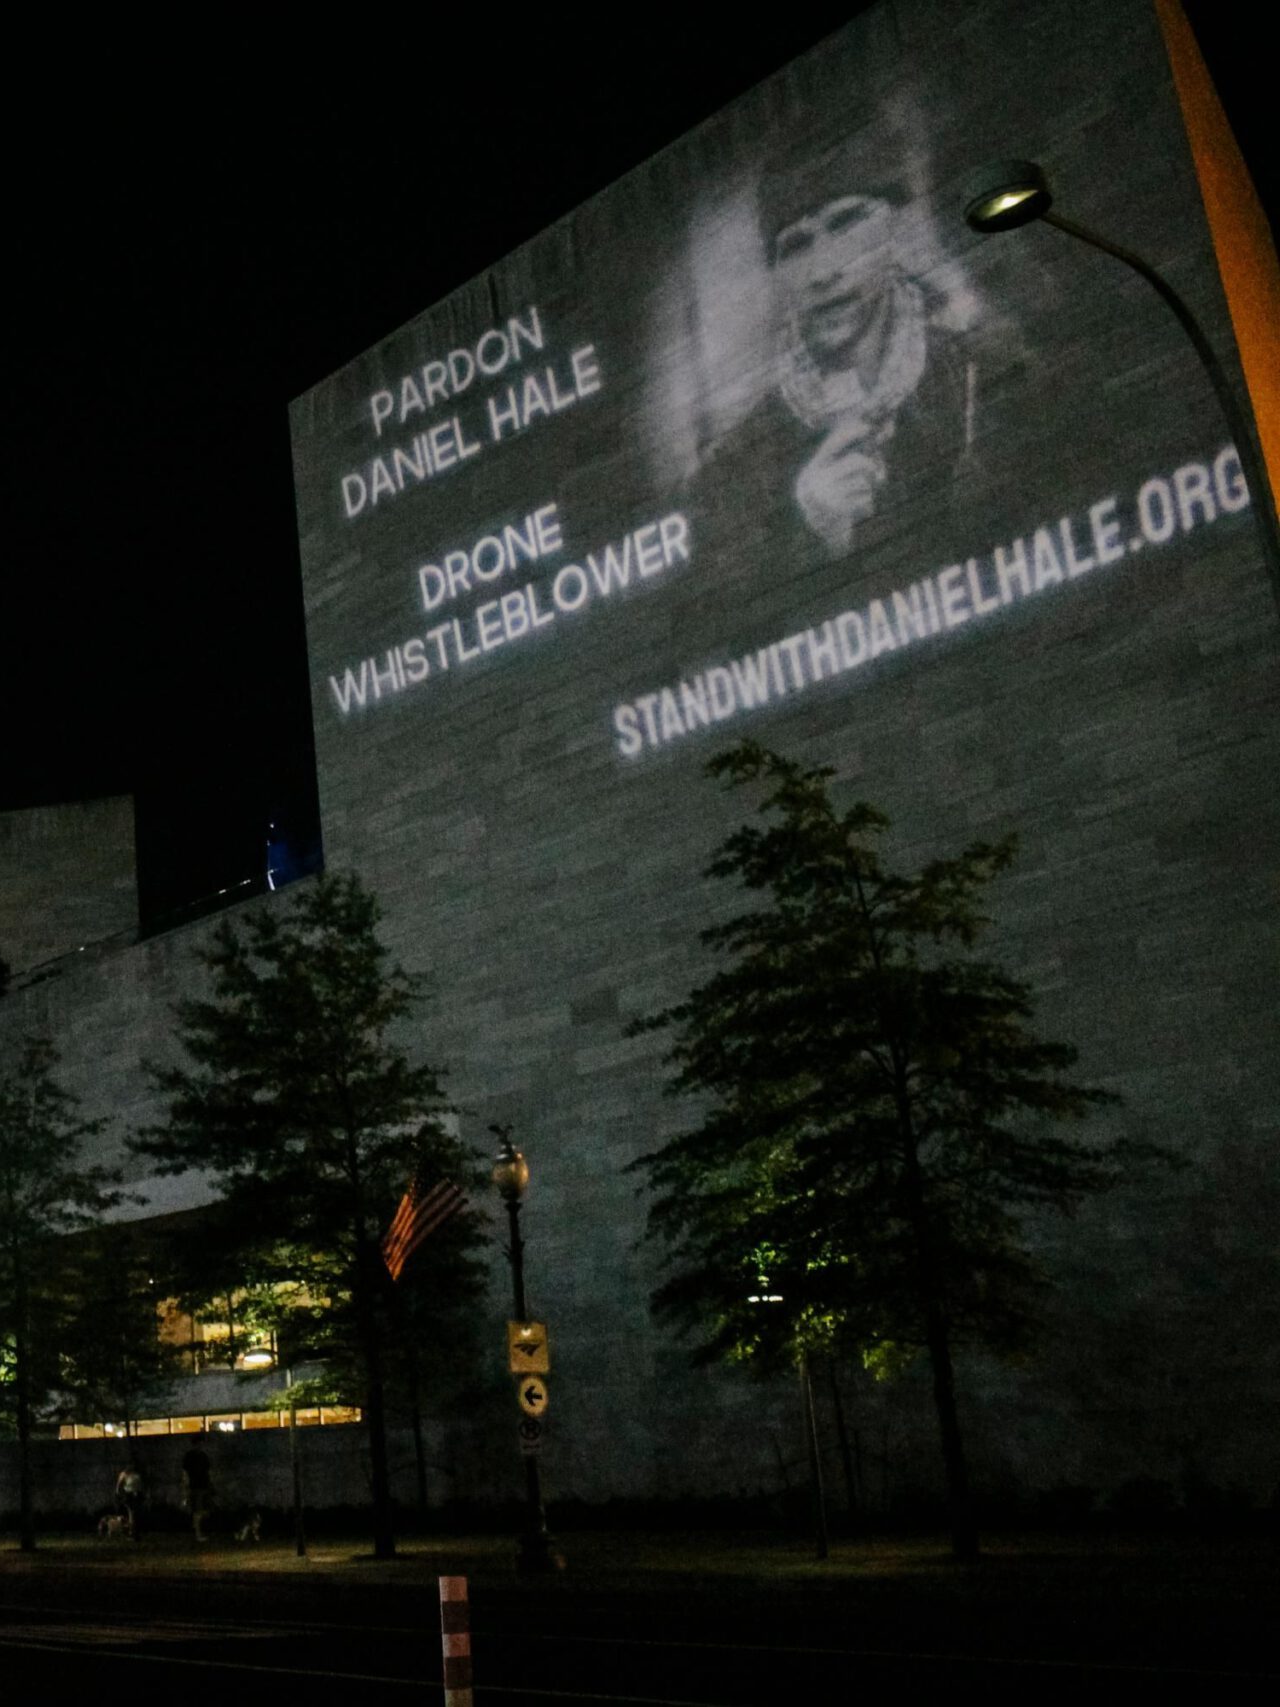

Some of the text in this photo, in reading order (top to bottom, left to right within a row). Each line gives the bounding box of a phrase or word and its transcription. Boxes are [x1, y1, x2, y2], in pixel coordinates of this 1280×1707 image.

[341, 344, 602, 518] DANIEL HALE
[370, 306, 544, 437] PARDON
[329, 512, 690, 714] WHISTLEBLOWER
[419, 502, 563, 611] DRONE
[614, 442, 1250, 757] STANDWITHDANIELHALE.ORG
